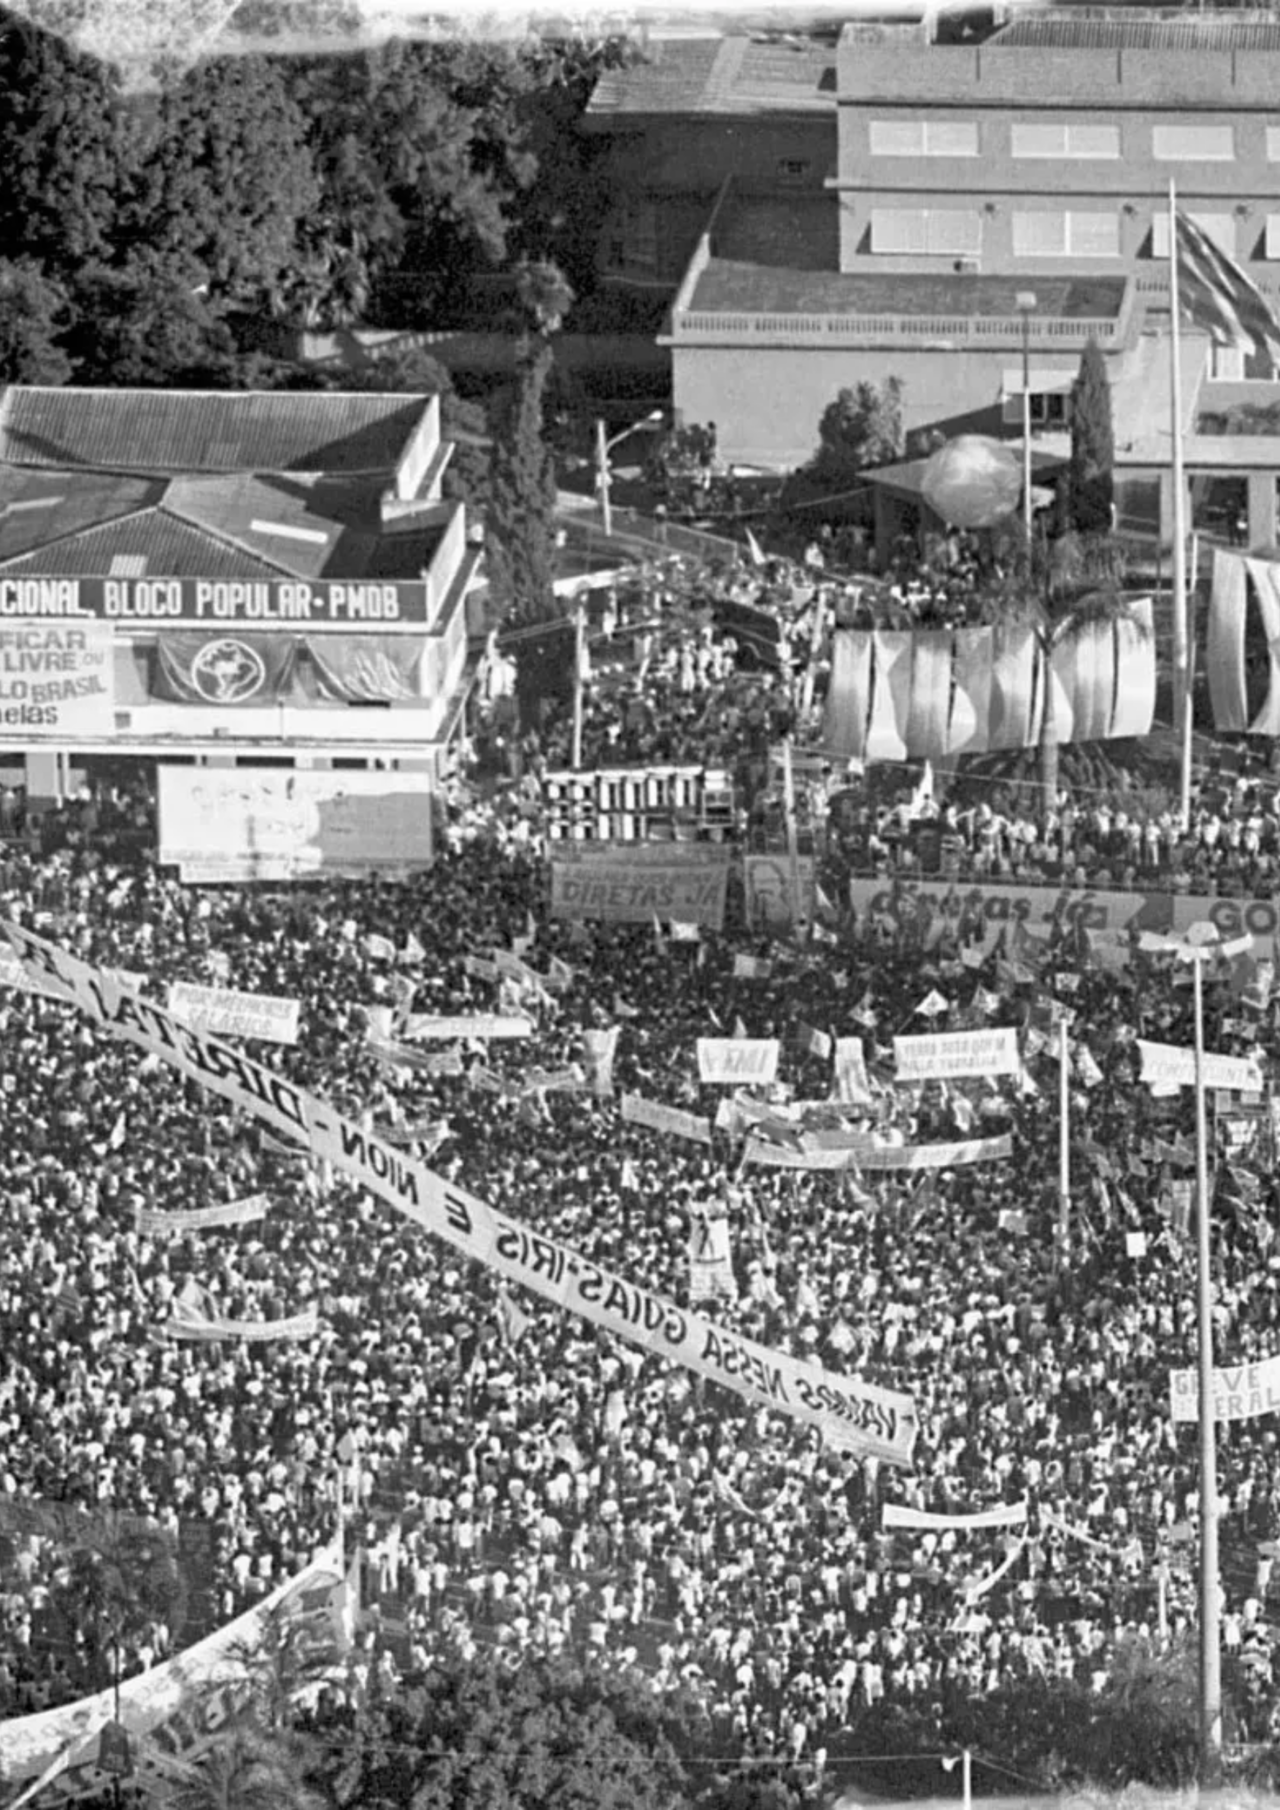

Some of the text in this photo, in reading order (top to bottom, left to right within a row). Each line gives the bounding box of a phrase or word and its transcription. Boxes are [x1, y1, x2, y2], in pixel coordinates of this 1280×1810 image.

[104, 580, 182, 616] BLOCO
[329, 585, 400, 619] PMDB
[4, 651, 78, 672] LIVRE
[31, 674, 107, 704] BRASIL
[0, 703, 58, 725] elas
[1174, 1366, 1261, 1396] GVE
